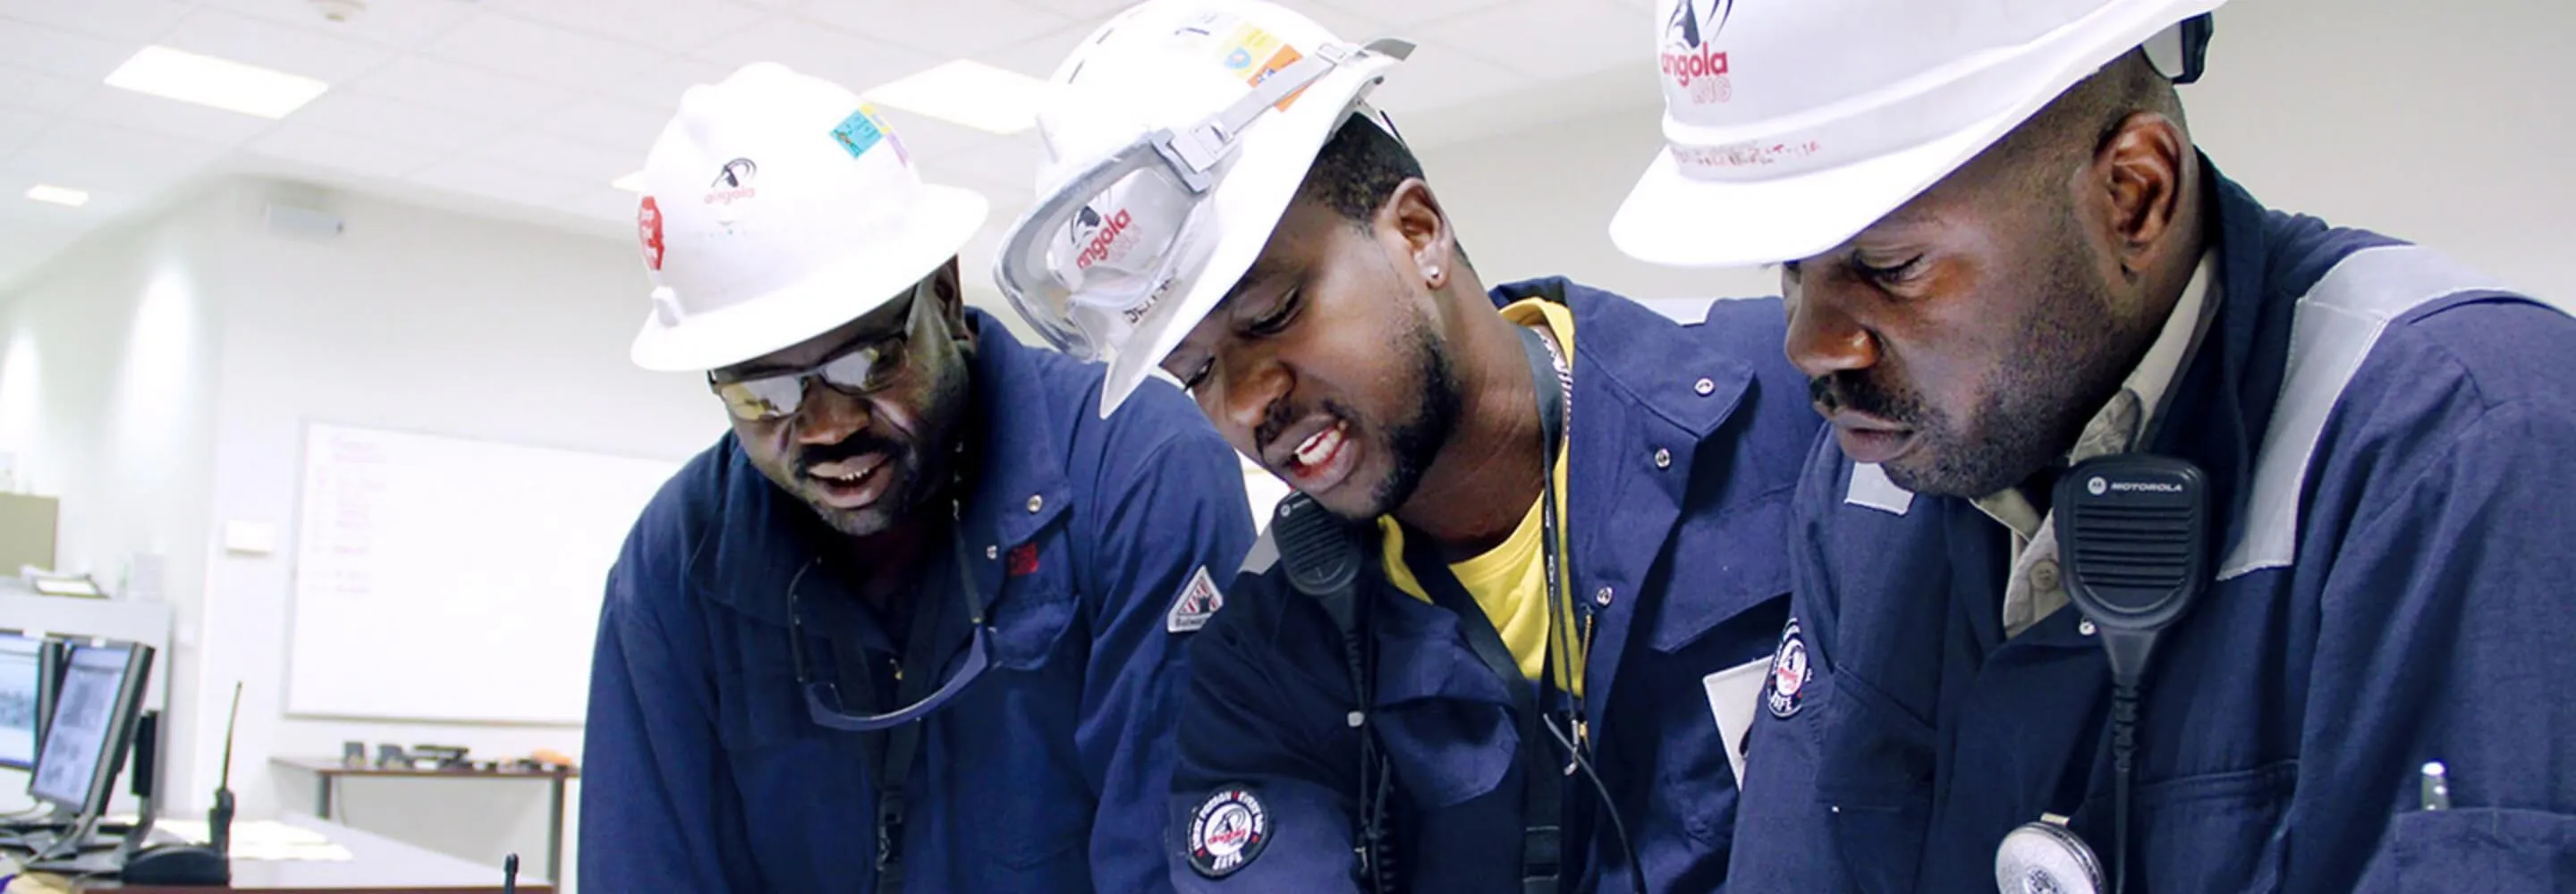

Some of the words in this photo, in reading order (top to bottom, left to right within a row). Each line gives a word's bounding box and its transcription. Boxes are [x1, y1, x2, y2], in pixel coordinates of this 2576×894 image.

[1661, 40, 1728, 87] angola
[1076, 208, 1131, 269] angola
[2111, 482, 2182, 493] MOTOROLA
